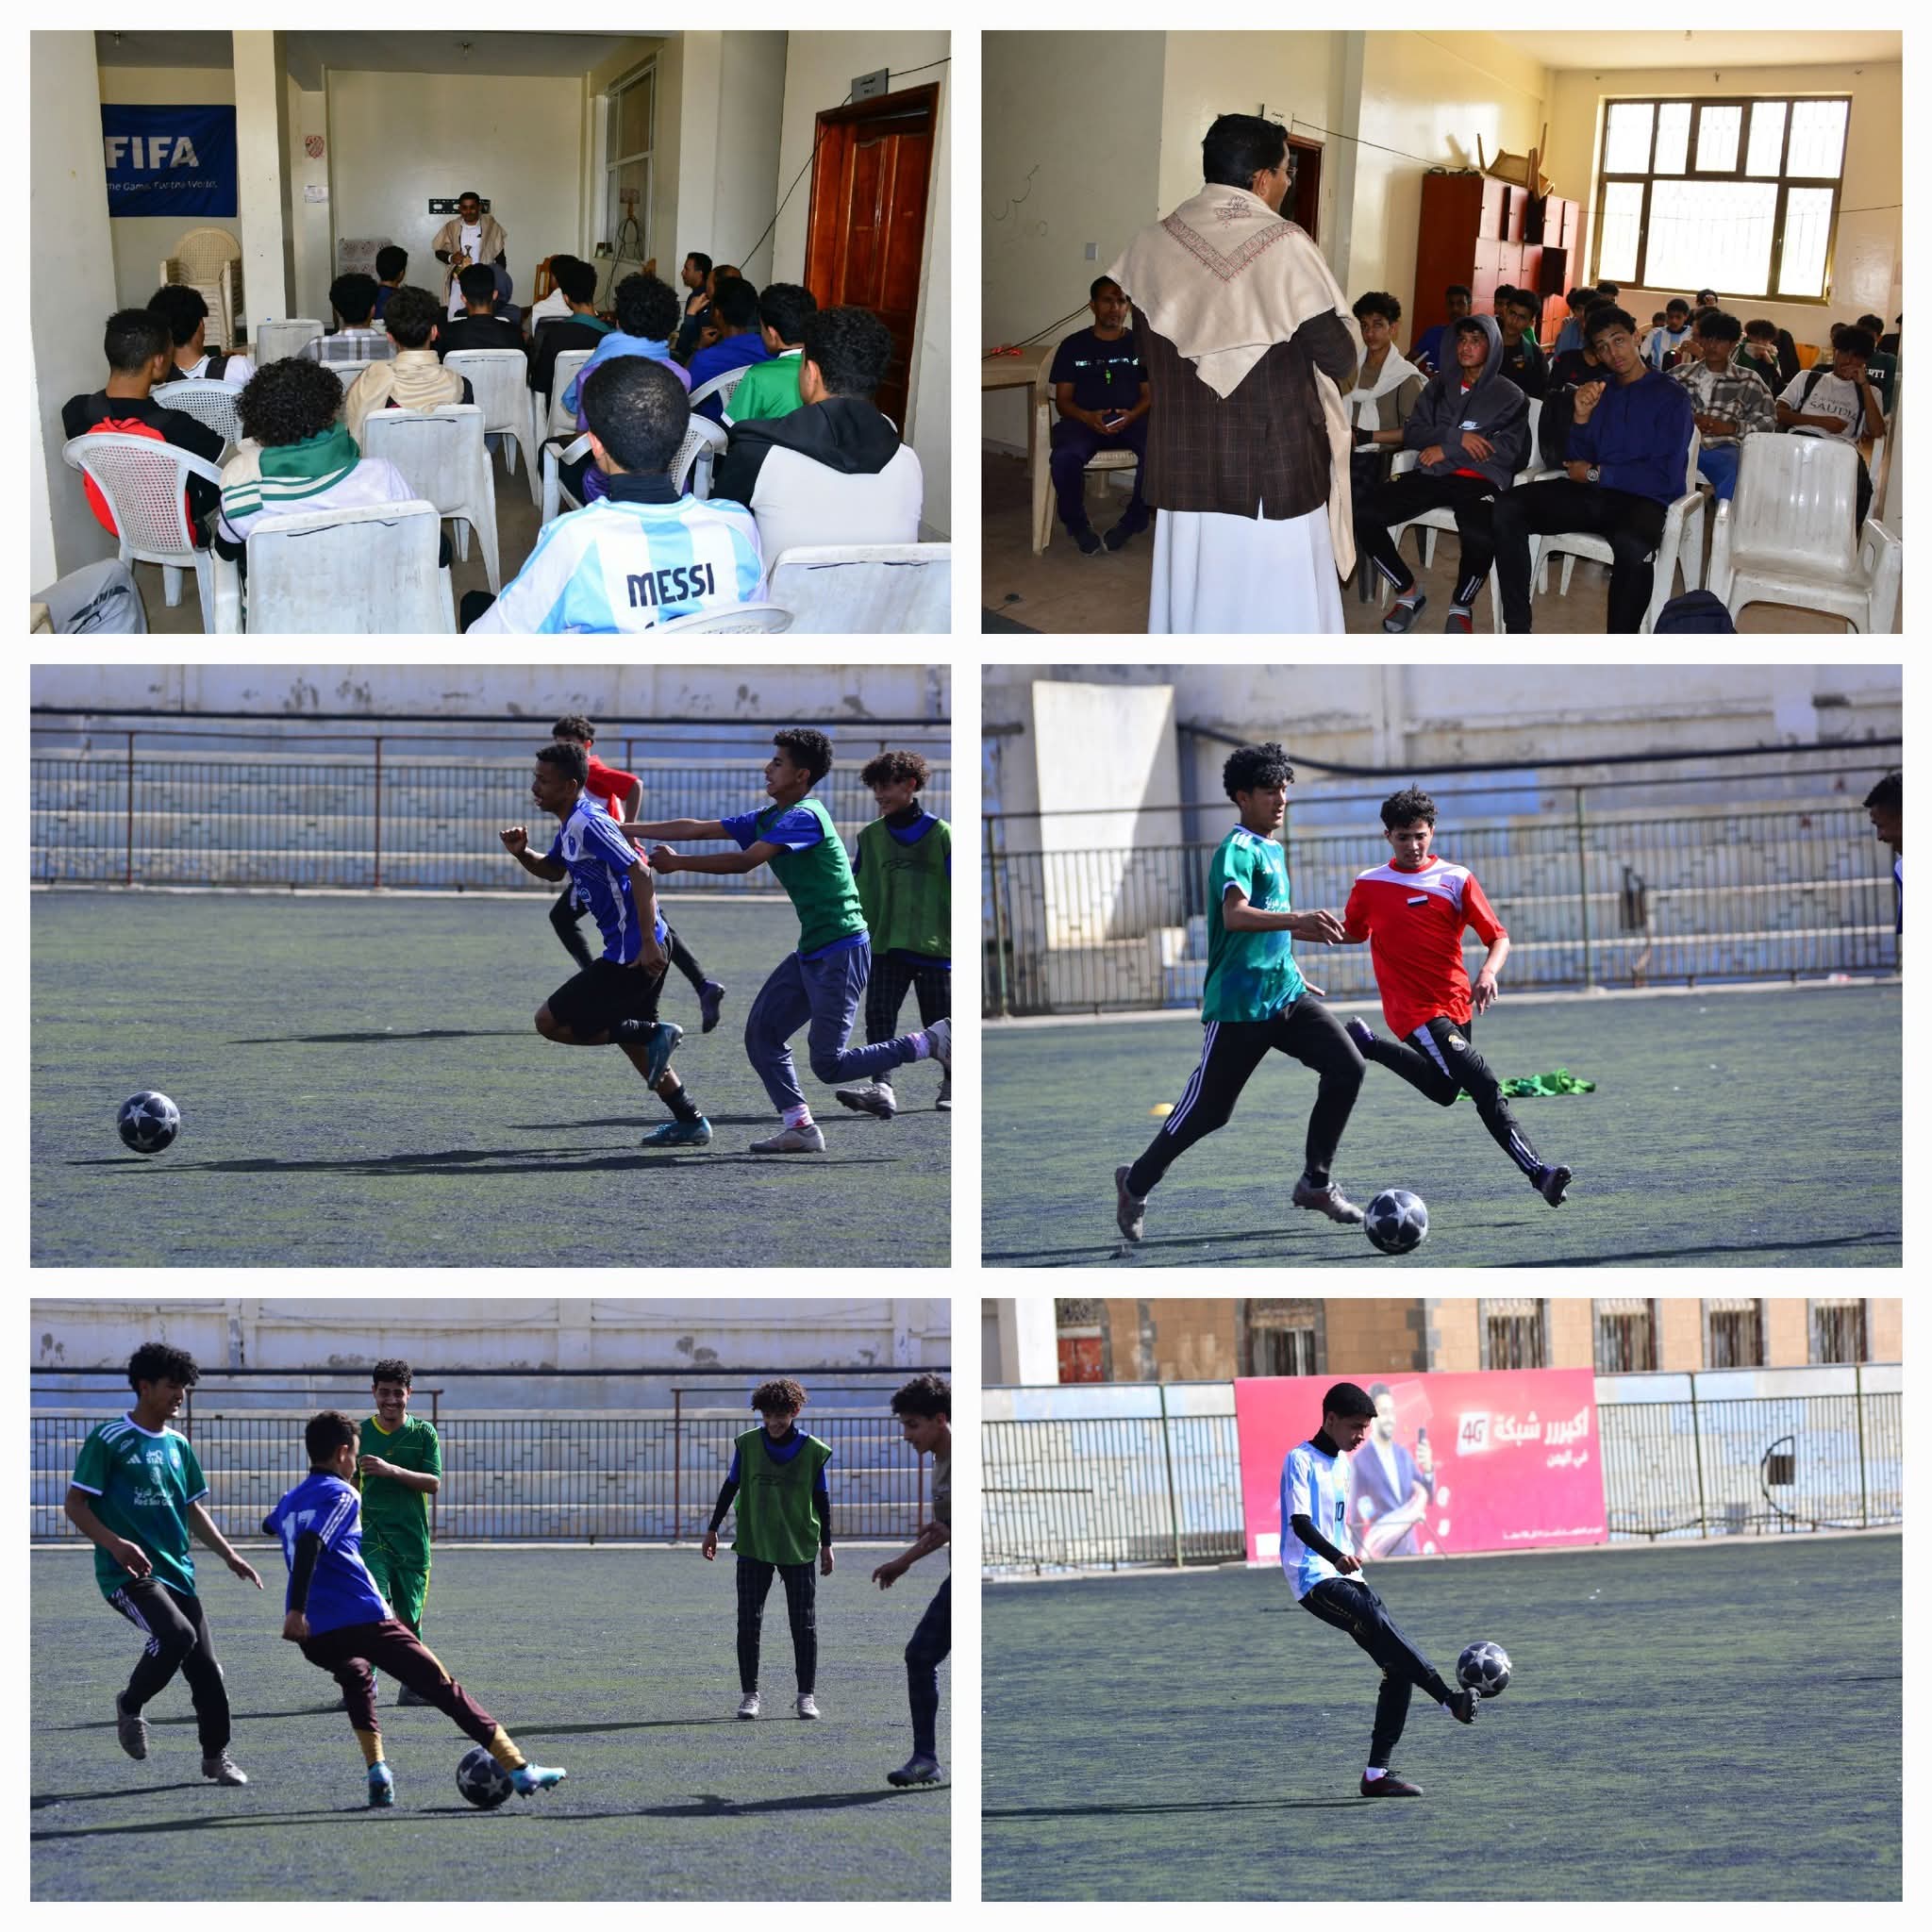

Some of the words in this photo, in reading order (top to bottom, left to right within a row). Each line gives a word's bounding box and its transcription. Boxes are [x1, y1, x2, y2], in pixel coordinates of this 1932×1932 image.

[105, 136, 199, 169] FIFA
[626, 562, 714, 608] MESSI
[1461, 1419, 1486, 1444] 4G
[1494, 1411, 1541, 1446] شبكة
[1335, 1501, 1344, 1523] 10
